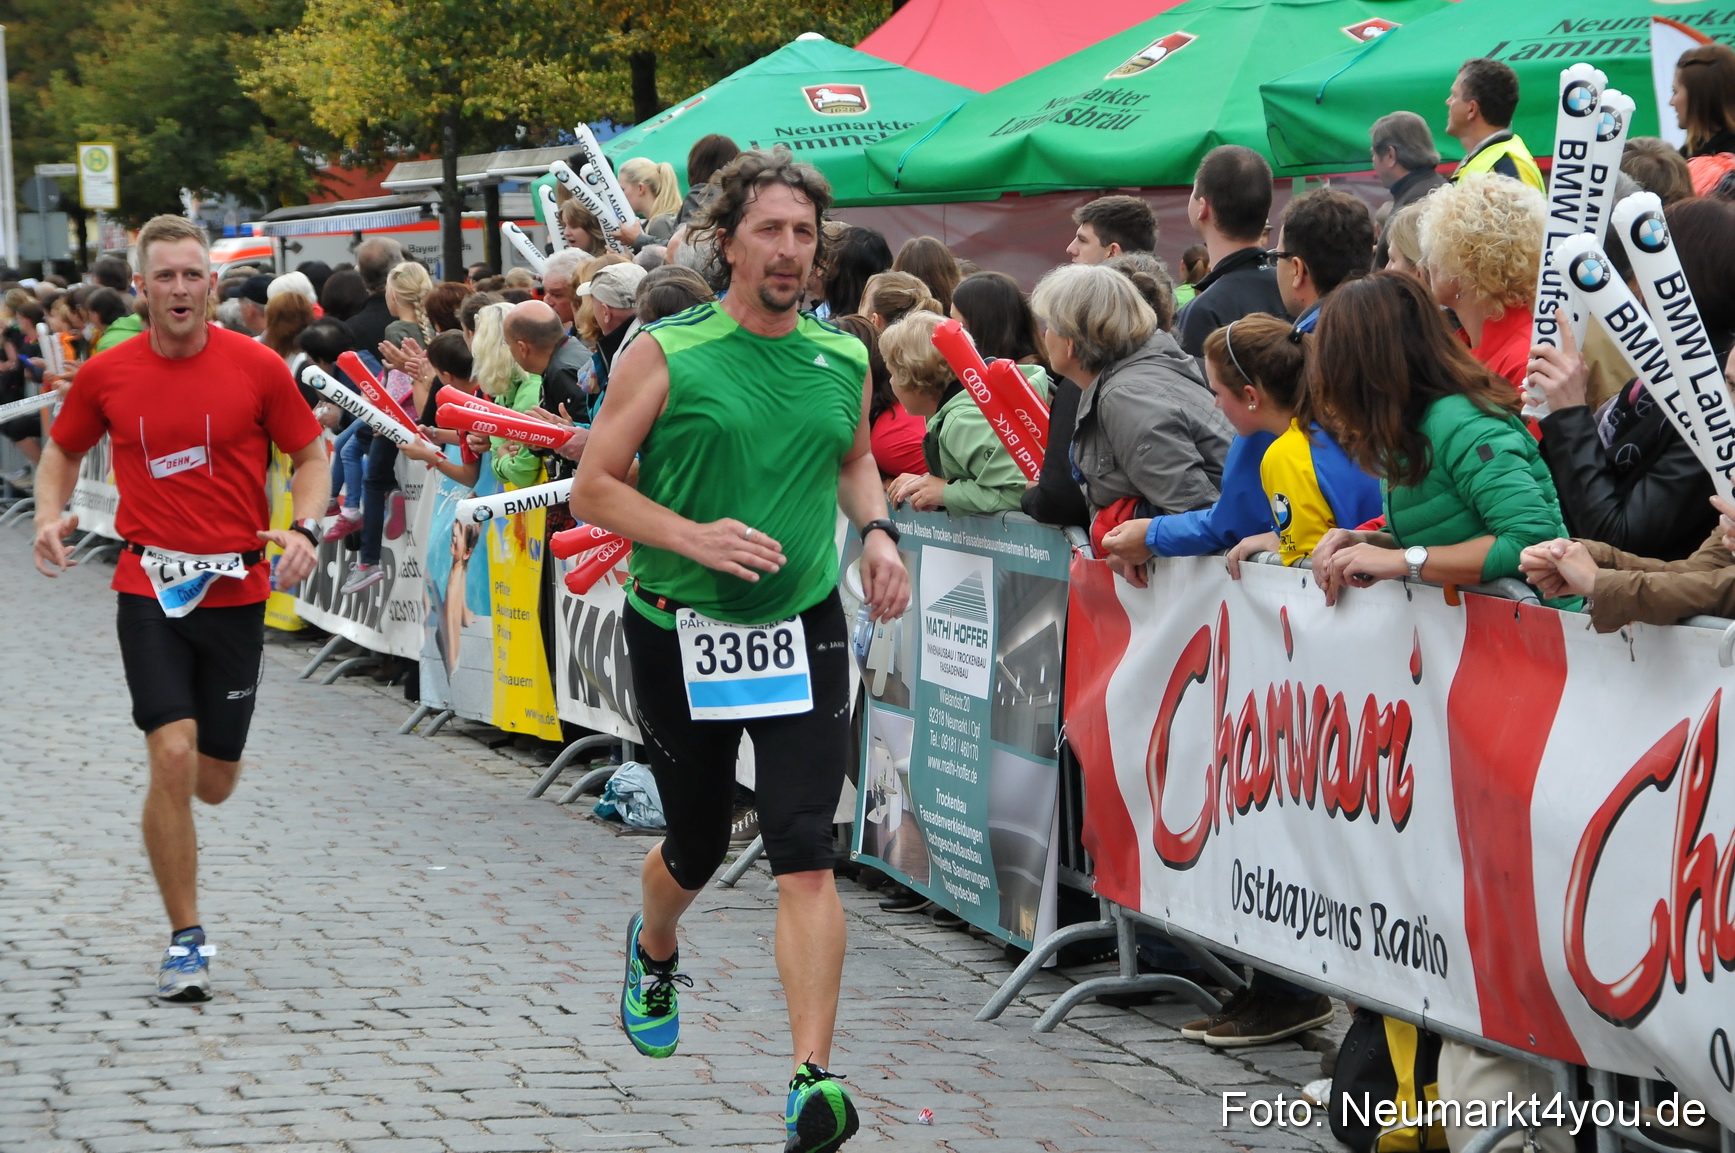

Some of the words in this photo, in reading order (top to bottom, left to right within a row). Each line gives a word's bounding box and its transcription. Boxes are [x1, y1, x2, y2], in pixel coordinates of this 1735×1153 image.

[1549, 139, 1588, 224] BMW
[1653, 269, 1712, 361] BMW
[1604, 300, 1674, 385] BMW
[330, 389, 369, 418] BMW
[505, 428, 528, 439] BKK
[528, 433, 556, 445] Audi
[993, 413, 1020, 446] BKK
[166, 455, 190, 470] DEHN
[503, 493, 549, 516] BMW
[926, 615, 952, 641] MATHI
[952, 622, 988, 650] HOFFER
[694, 628, 795, 675] 3368
[957, 651, 987, 669] TROCKENBAU
[939, 661, 969, 679] FASSADENBAU
[928, 706, 945, 727] 92318
[935, 787, 967, 815] Trockenbau
[919, 803, 983, 846] Fassadenverkleidungen
[951, 859, 991, 890] Sanierungen
[1230, 857, 1362, 952] Ostbayerns
[1370, 901, 1449, 980] Radio
